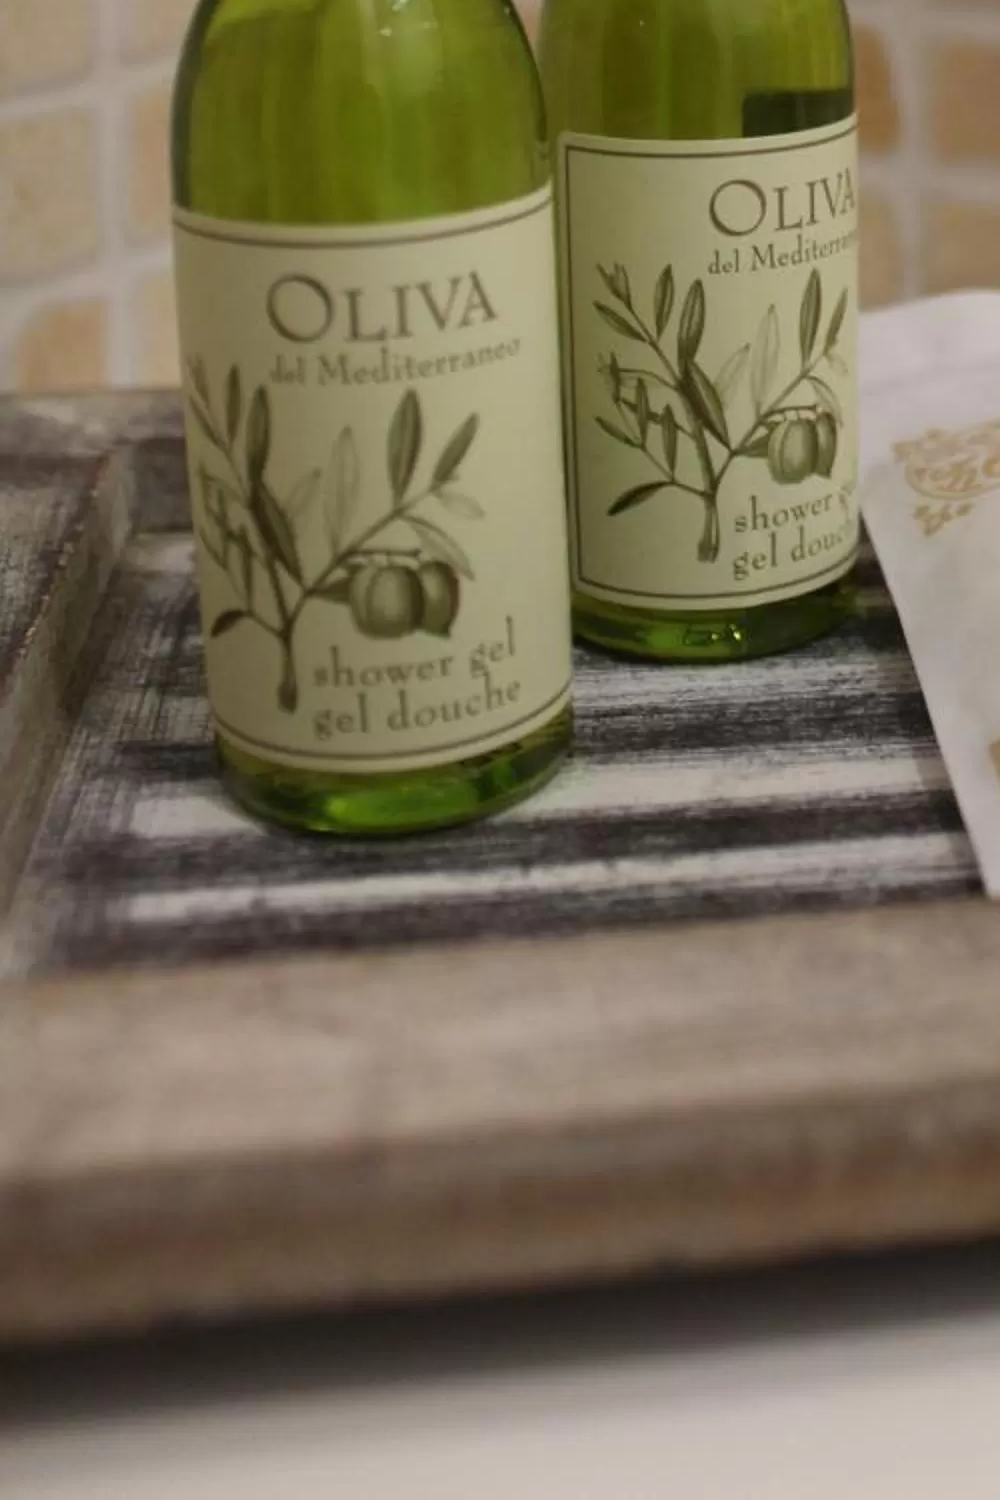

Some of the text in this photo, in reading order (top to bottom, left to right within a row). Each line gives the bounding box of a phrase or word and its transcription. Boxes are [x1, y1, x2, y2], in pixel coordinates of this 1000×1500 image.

[709, 167, 855, 237] OLIVA
[708, 248, 740, 275] del
[266, 271, 498, 343] OLIVA
[269, 337, 521, 386] del Mediterraneo
[734, 494, 832, 533] shower
[733, 531, 778, 581] gel
[313, 615, 515, 688] shower gel
[312, 668, 521, 741] gel douche
